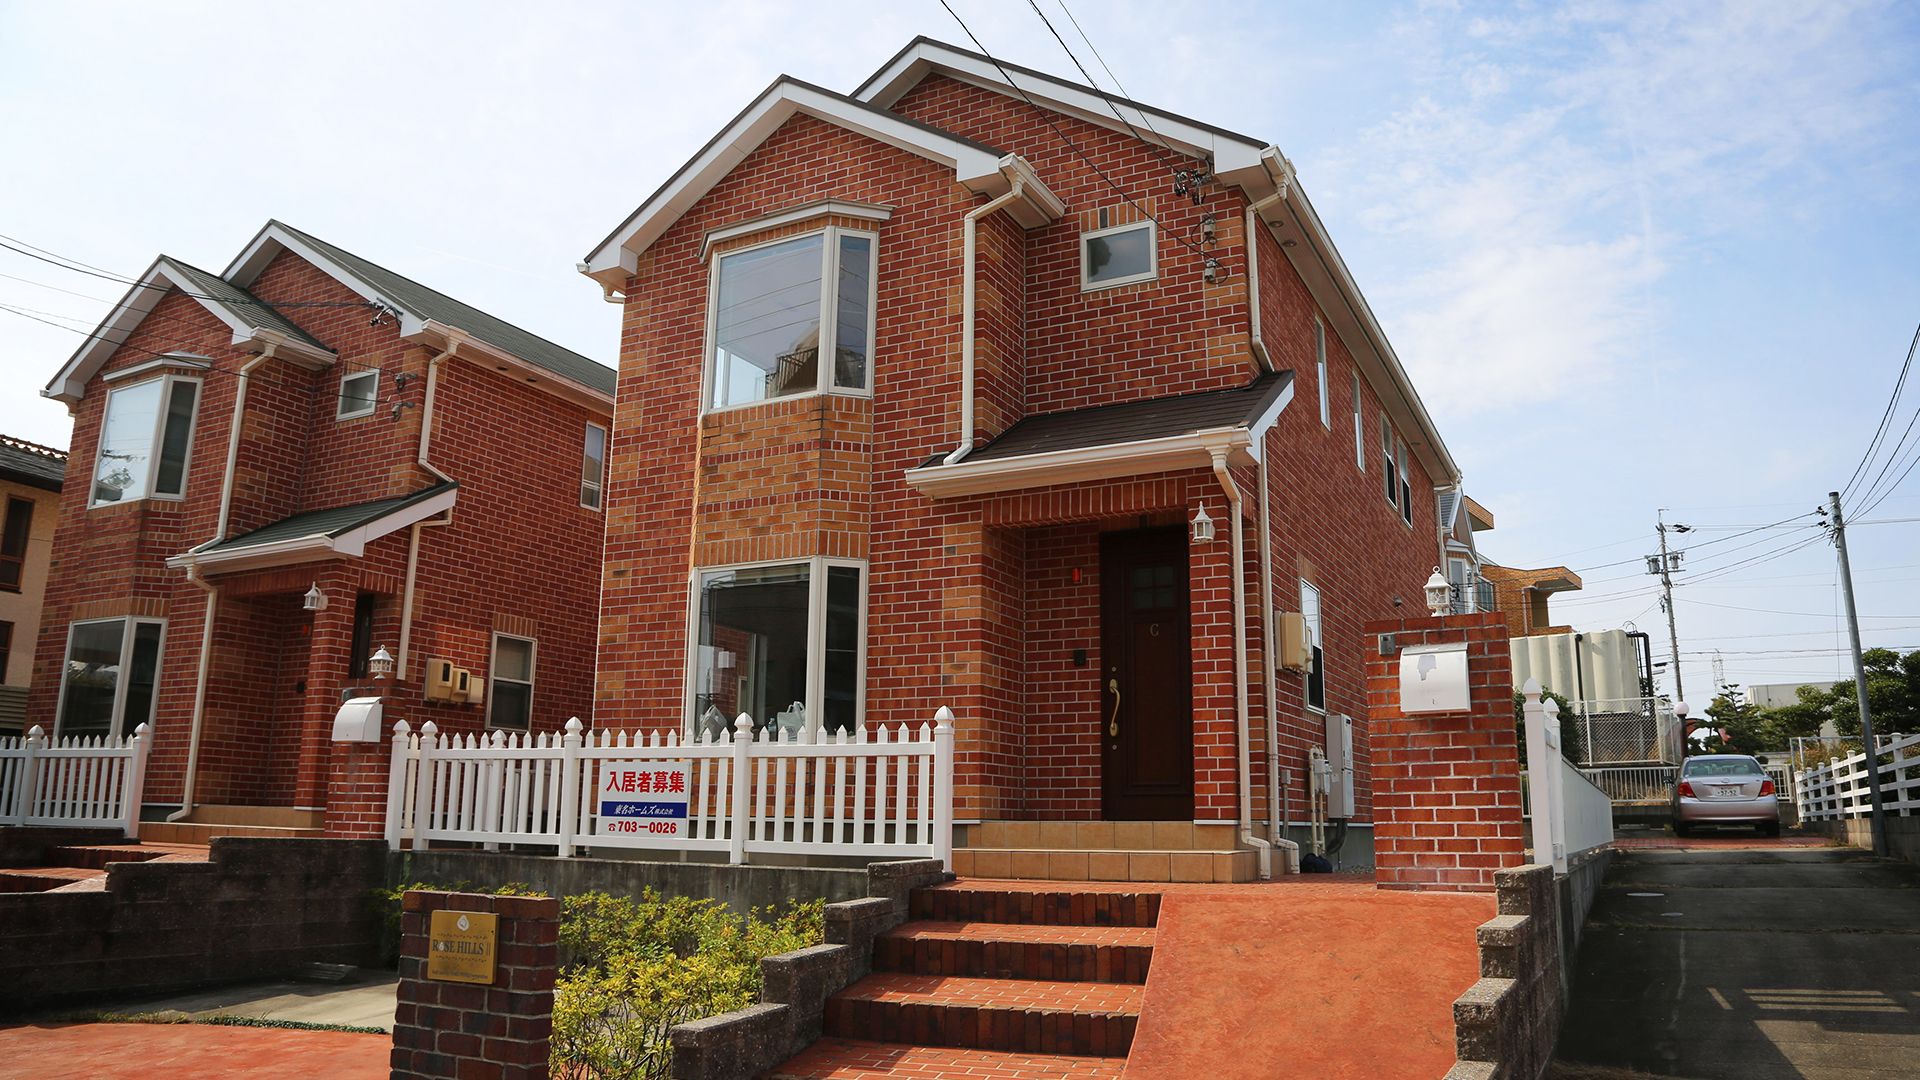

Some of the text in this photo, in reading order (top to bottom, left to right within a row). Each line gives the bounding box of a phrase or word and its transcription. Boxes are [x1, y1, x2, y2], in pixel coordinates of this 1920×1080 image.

[606, 770, 685, 793] 入居者募集
[618, 821, 677, 834] 703-0026
[432, 939, 455, 953] ROSE
[458, 941, 484, 954] HILLS
